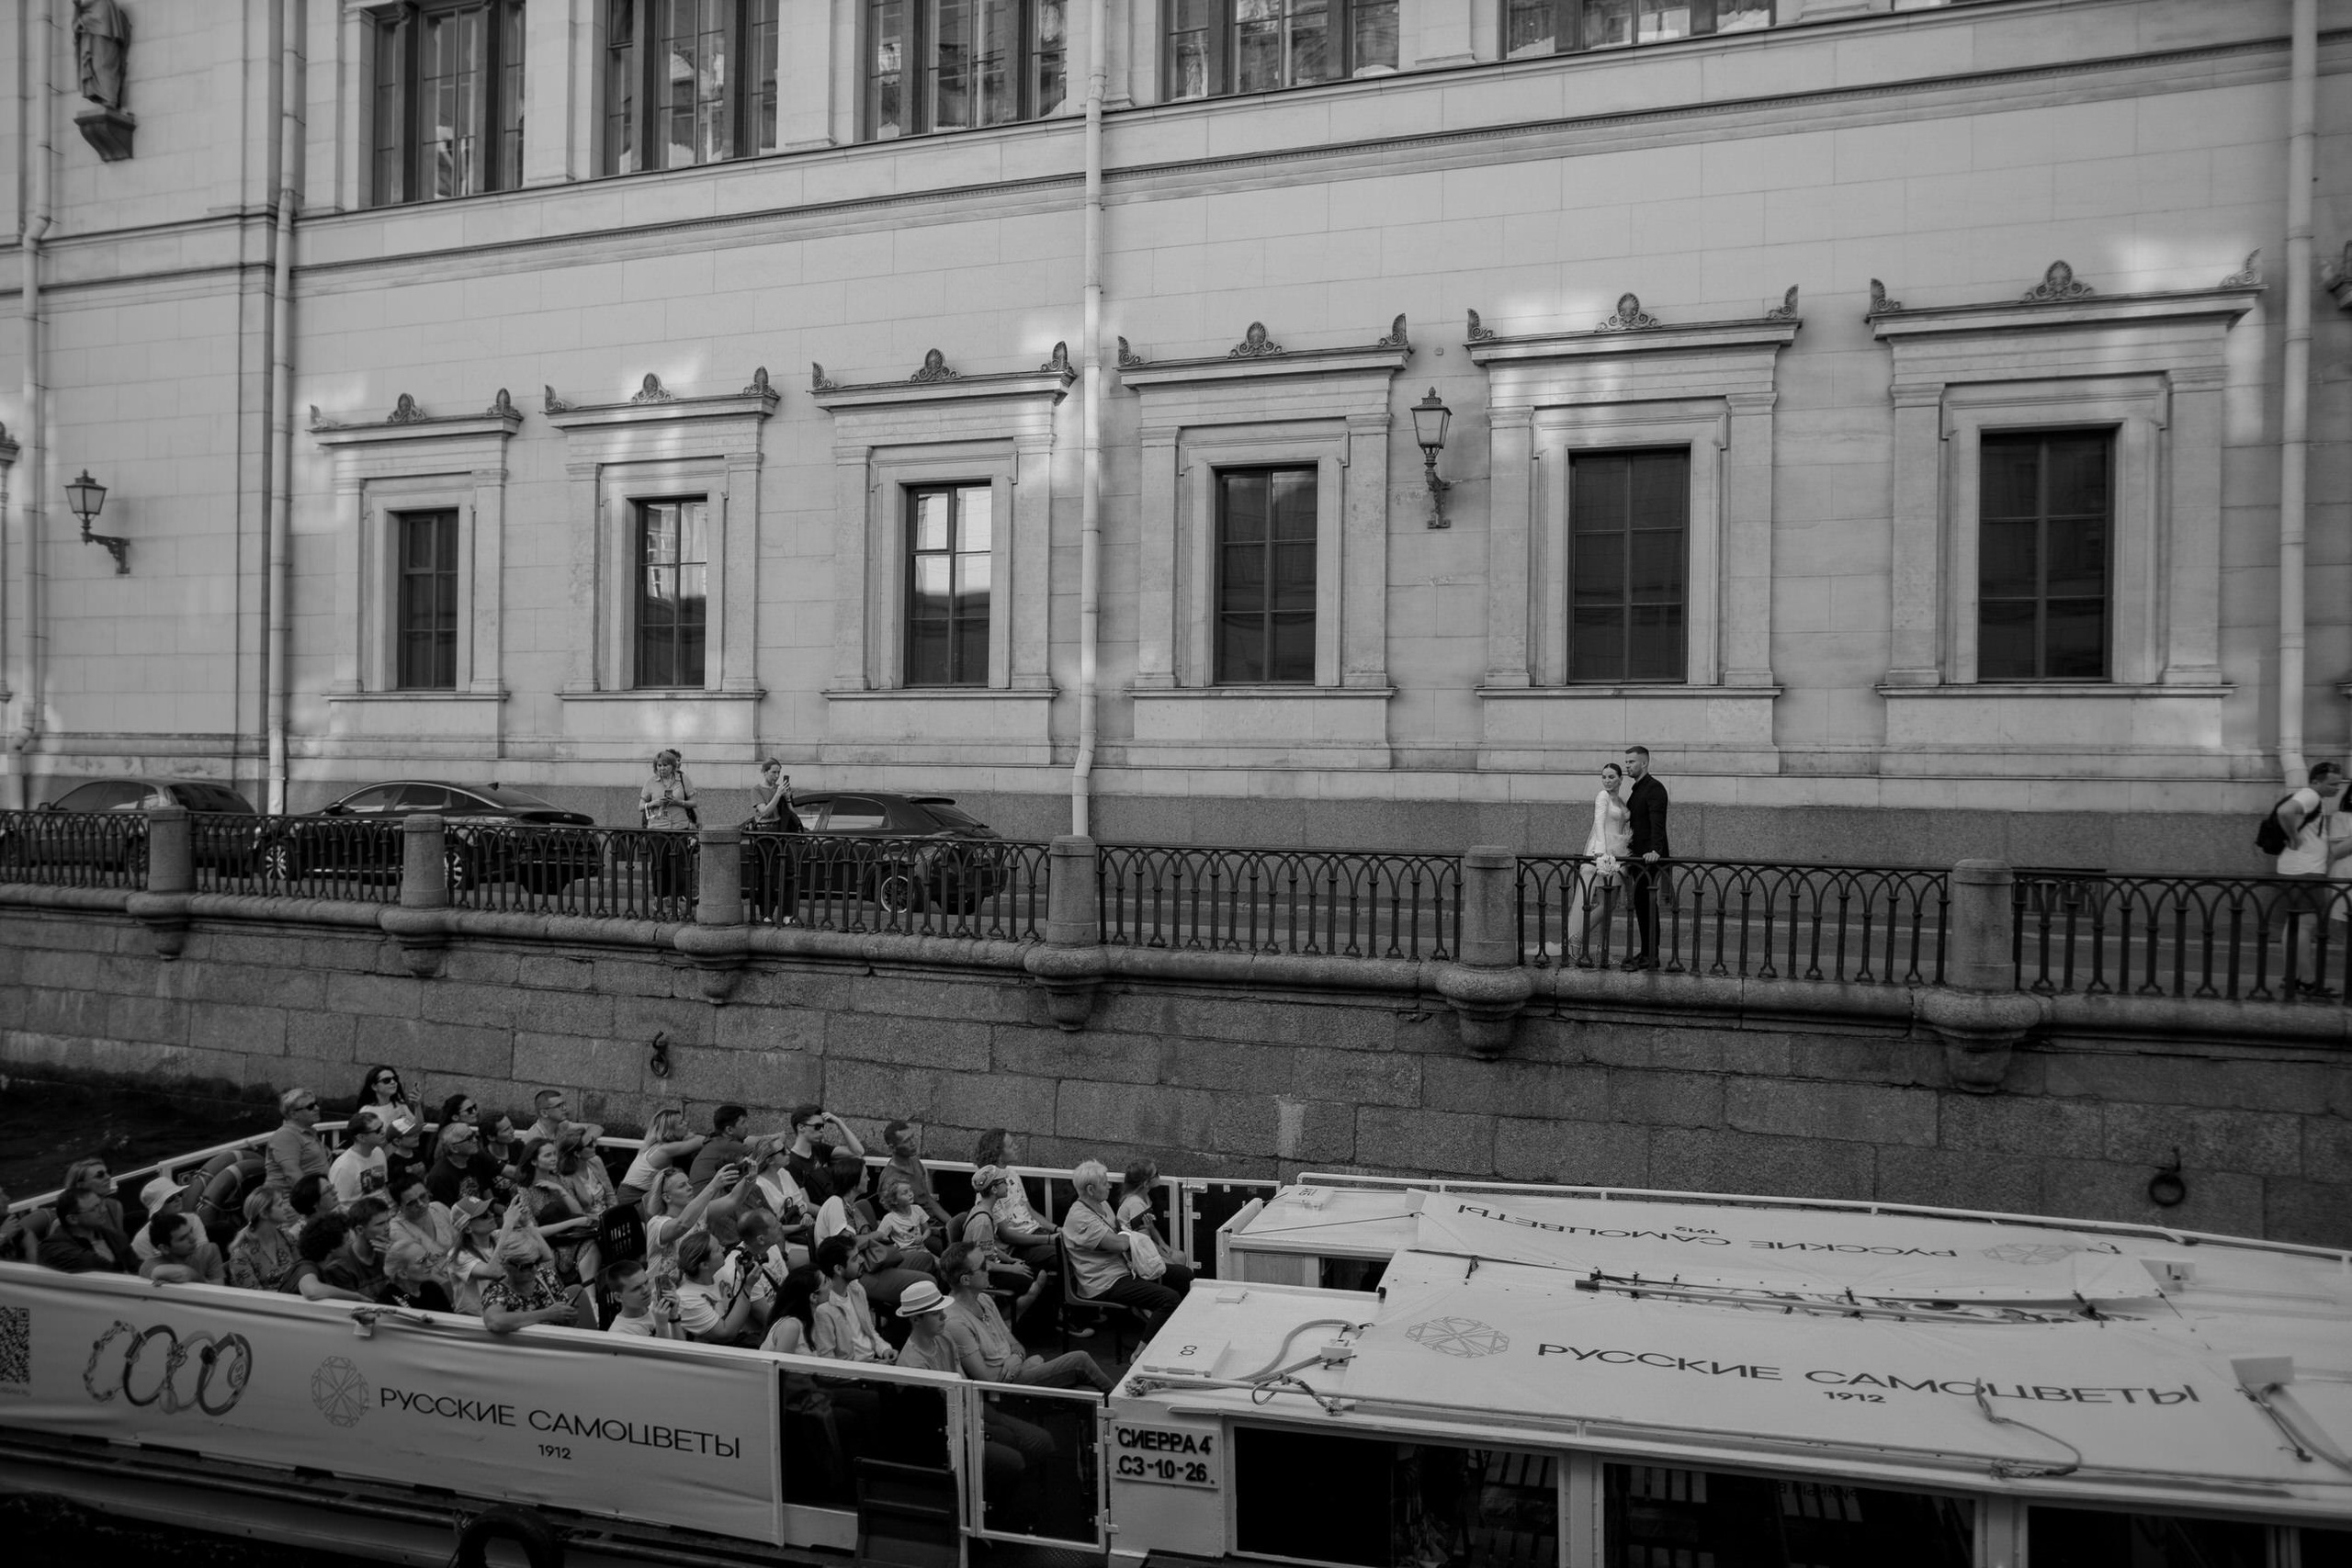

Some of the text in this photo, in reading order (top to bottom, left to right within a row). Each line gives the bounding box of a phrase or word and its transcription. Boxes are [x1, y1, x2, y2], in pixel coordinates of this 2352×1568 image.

[1457, 1204, 1958, 1258] РУССКИЕ САМОЦВЕТЫ
[1675, 1225, 1719, 1235] 1912
[1537, 1343, 2201, 1406] РУССКИЕ САМОЦВЕТЫ
[1823, 1391, 1888, 1404] 1912
[379, 1387, 741, 1460] РУССКИЕ САМОЦВЕТЫ
[537, 1444, 572, 1461] 1912
[1117, 1427, 1213, 1455] СИЕРРА 4
